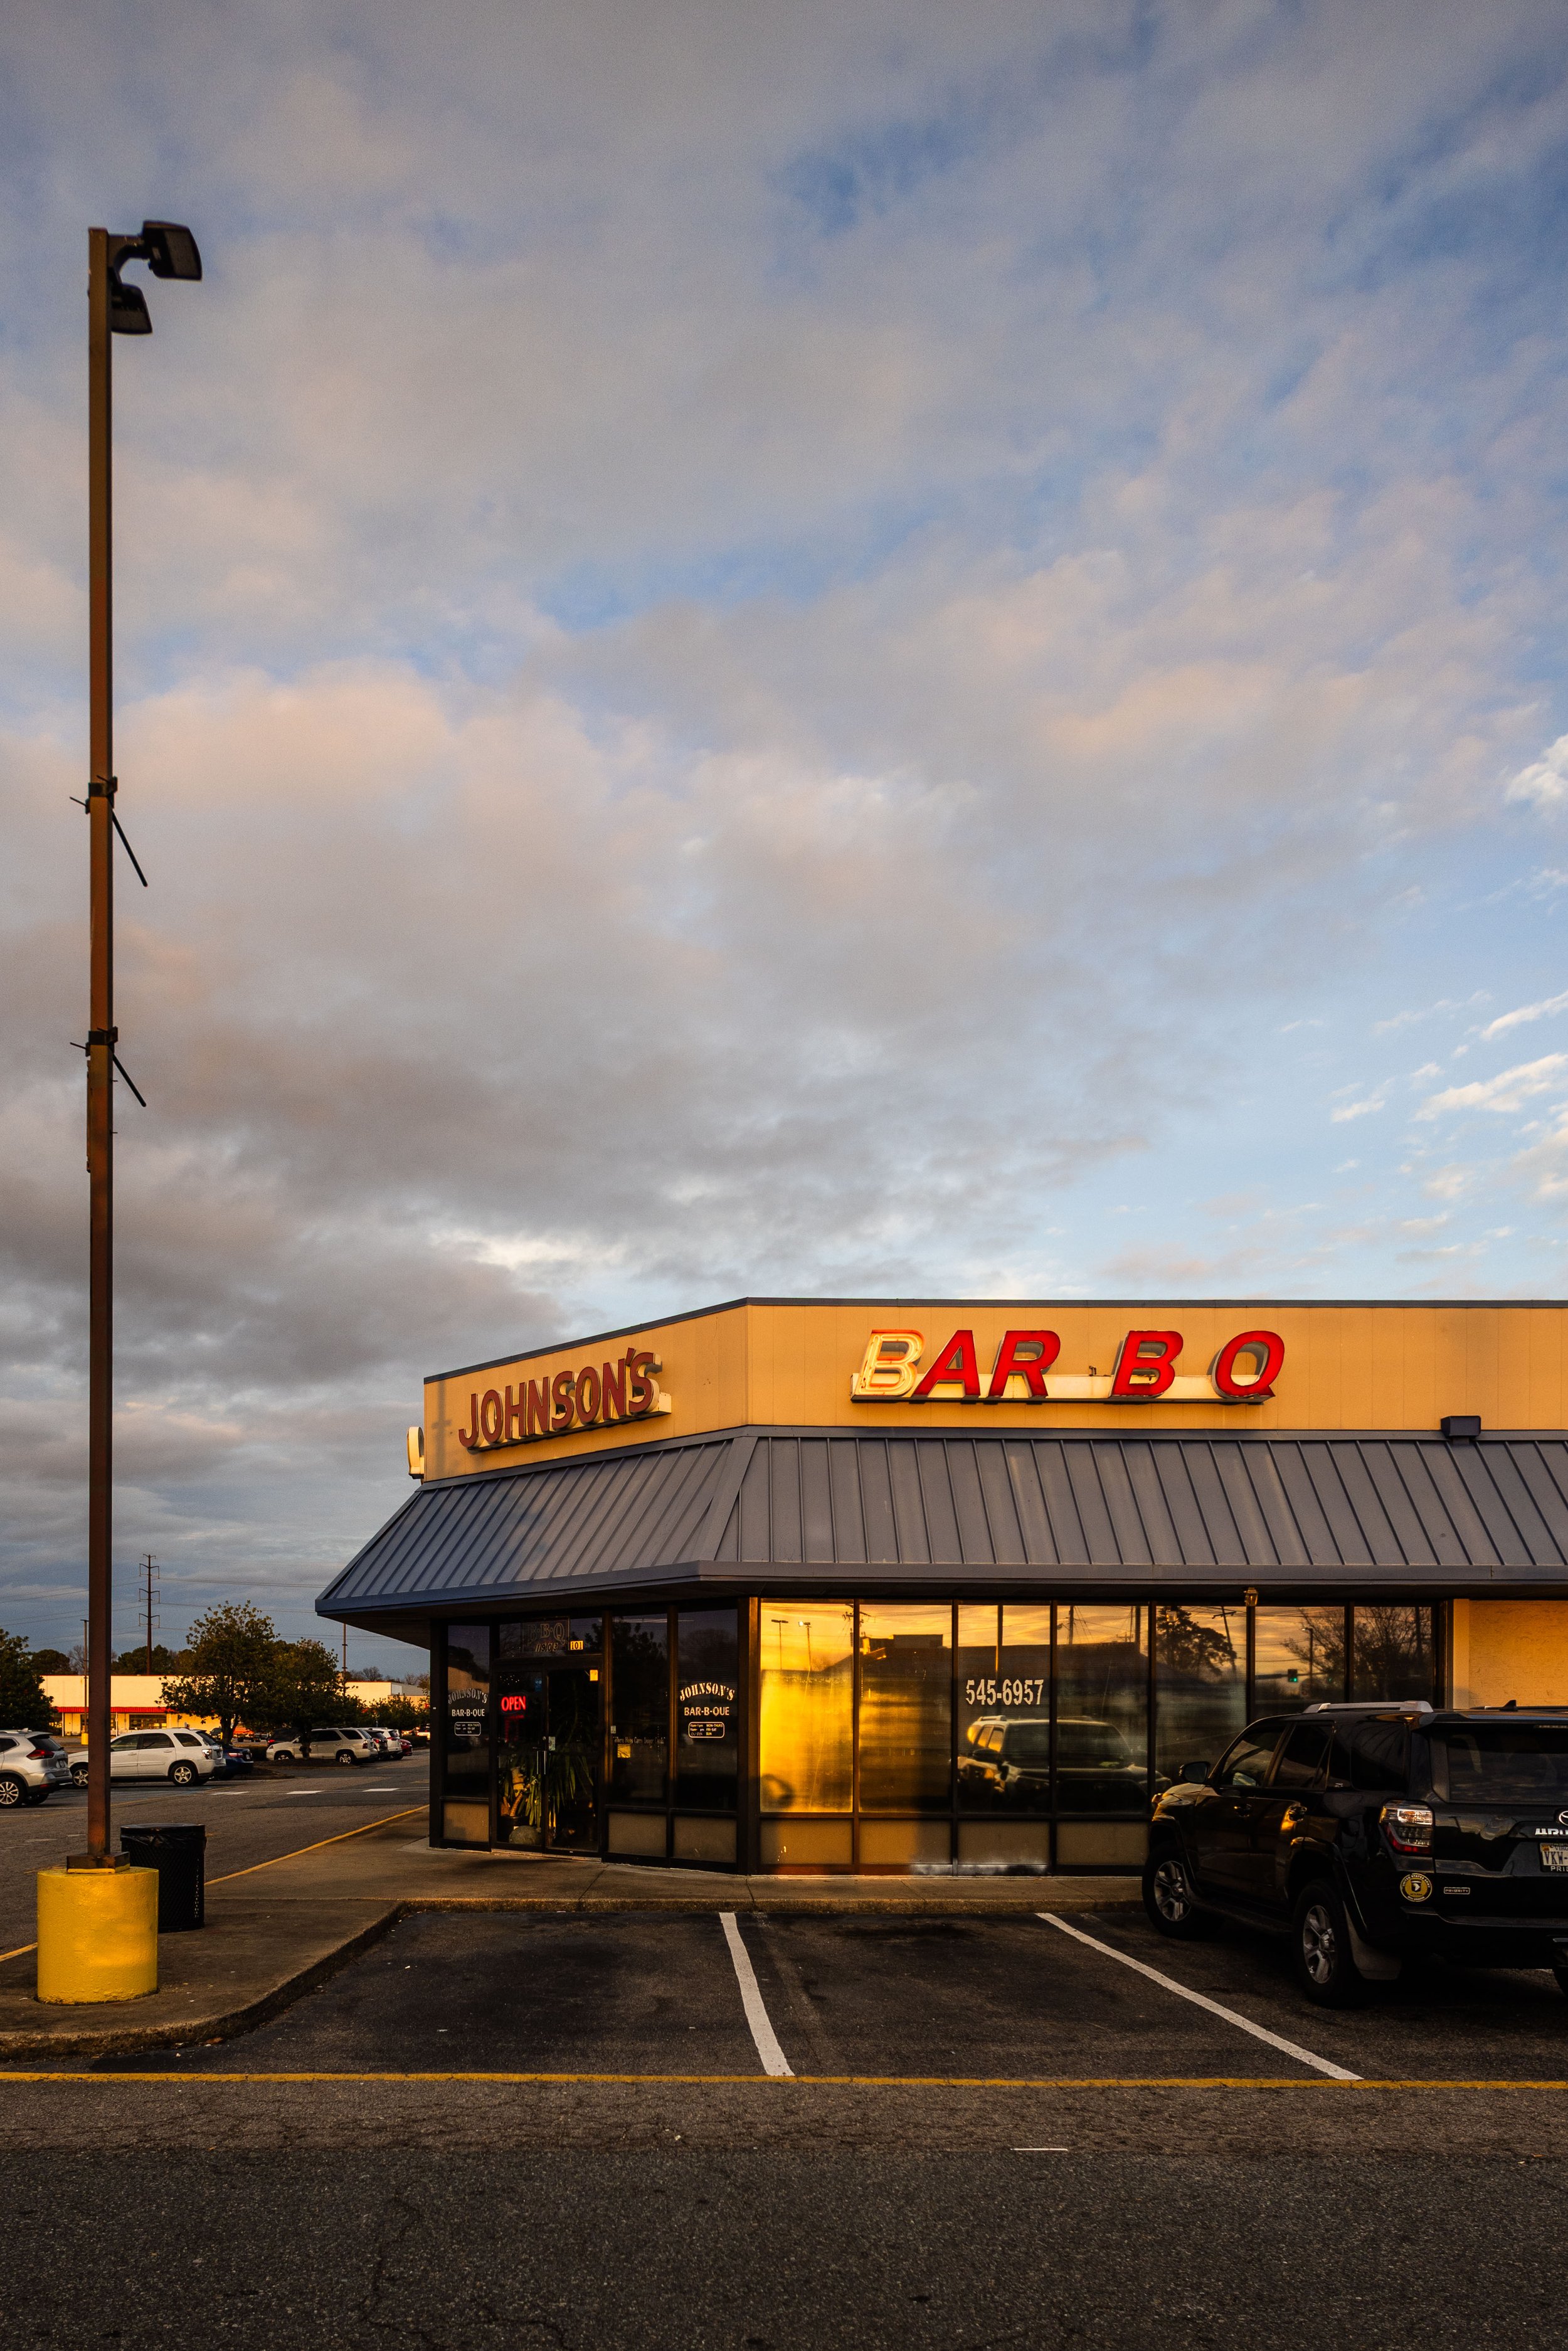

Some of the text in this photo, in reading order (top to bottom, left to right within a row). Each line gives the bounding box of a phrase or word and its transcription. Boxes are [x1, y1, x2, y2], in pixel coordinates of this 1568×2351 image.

[859, 1329, 1285, 1398] BAR B Q
[458, 1347, 657, 1448] JOHNSON'S
[448, 1687, 489, 1704] JOHNSON'S
[679, 1682, 735, 1701] JOHNSON'S
[965, 1679, 1044, 1706] 545-6957
[451, 1708, 485, 1717] BAR-B-QUE
[501, 1696, 527, 1712] OPEN
[684, 1706, 730, 1716] BAR-B-QUE
